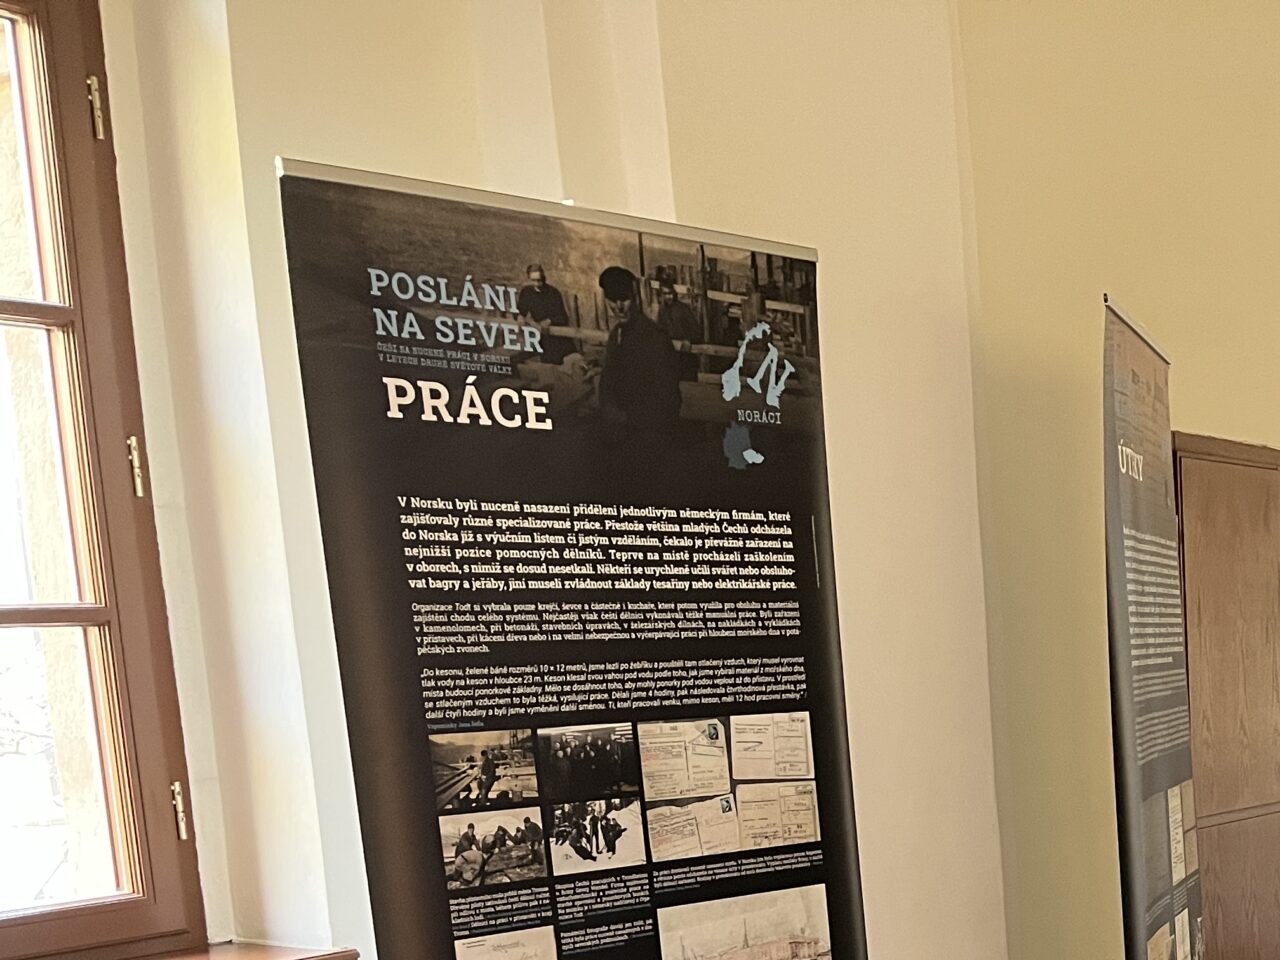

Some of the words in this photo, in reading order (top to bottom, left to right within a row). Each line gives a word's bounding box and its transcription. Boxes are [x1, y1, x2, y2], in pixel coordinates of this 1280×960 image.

[367, 268, 520, 314] POSLÁNI
[373, 307, 425, 340] NA
[435, 315, 544, 353] SEVER
[382, 375, 553, 430] PRÁCE
[397, 495, 406, 507] V
[410, 496, 453, 509] Norsku
[455, 498, 478, 512] byli
[480, 499, 520, 512] nuceně
[522, 501, 570, 514] nasazeni
[572, 503, 618, 518] přiděleni
[619, 505, 677, 520] jednotlivým
[768, 509, 791, 521] které
[399, 513, 460, 528] zajišťovaly
[461, 515, 493, 527] různé
[495, 516, 571, 531] specializované
[572, 518, 603, 532] práce.
[604, 519, 644, 531] Přestože
[681, 521, 721, 535] mladých
[749, 523, 792, 535] odcházela
[401, 529, 417, 540] do
[418, 529, 459, 541] Norska
[460, 530, 474, 544] již
[475, 533, 483, 542] s
[484, 531, 532, 545] výučním
[533, 532, 566, 544] listem
[566, 533, 577, 544] či
[577, 533, 609, 547] jistým
[694, 536, 703, 549] je
[782, 540, 793, 548] na
[403, 545, 451, 559] nejnižší
[454, 546, 492, 560] pozice
[494, 547, 560, 561] pomocných
[610, 549, 644, 562] Teprve
[646, 552, 660, 560] na
[692, 550, 741, 564] procházeli
[405, 563, 414, 572] v
[415, 561, 462, 574] oborech,
[462, 564, 470, 573] s
[470, 562, 502, 573] nimiž
[502, 565, 515, 573] se
[515, 562, 547, 574] dosud
[547, 562, 595, 574] nesetkali.
[596, 563, 632, 575] Někteří
[632, 566, 643, 575] se
[738, 564, 760, 576] nebo
[407, 577, 427, 588] vat
[428, 577, 460, 590] bagry
[462, 580, 470, 588] a
[508, 577, 526, 591] jiní
[527, 577, 562, 589] museli
[563, 578, 613, 589] zvládnout
[613, 578, 651, 591] základy
[691, 578, 713, 589] nebo
